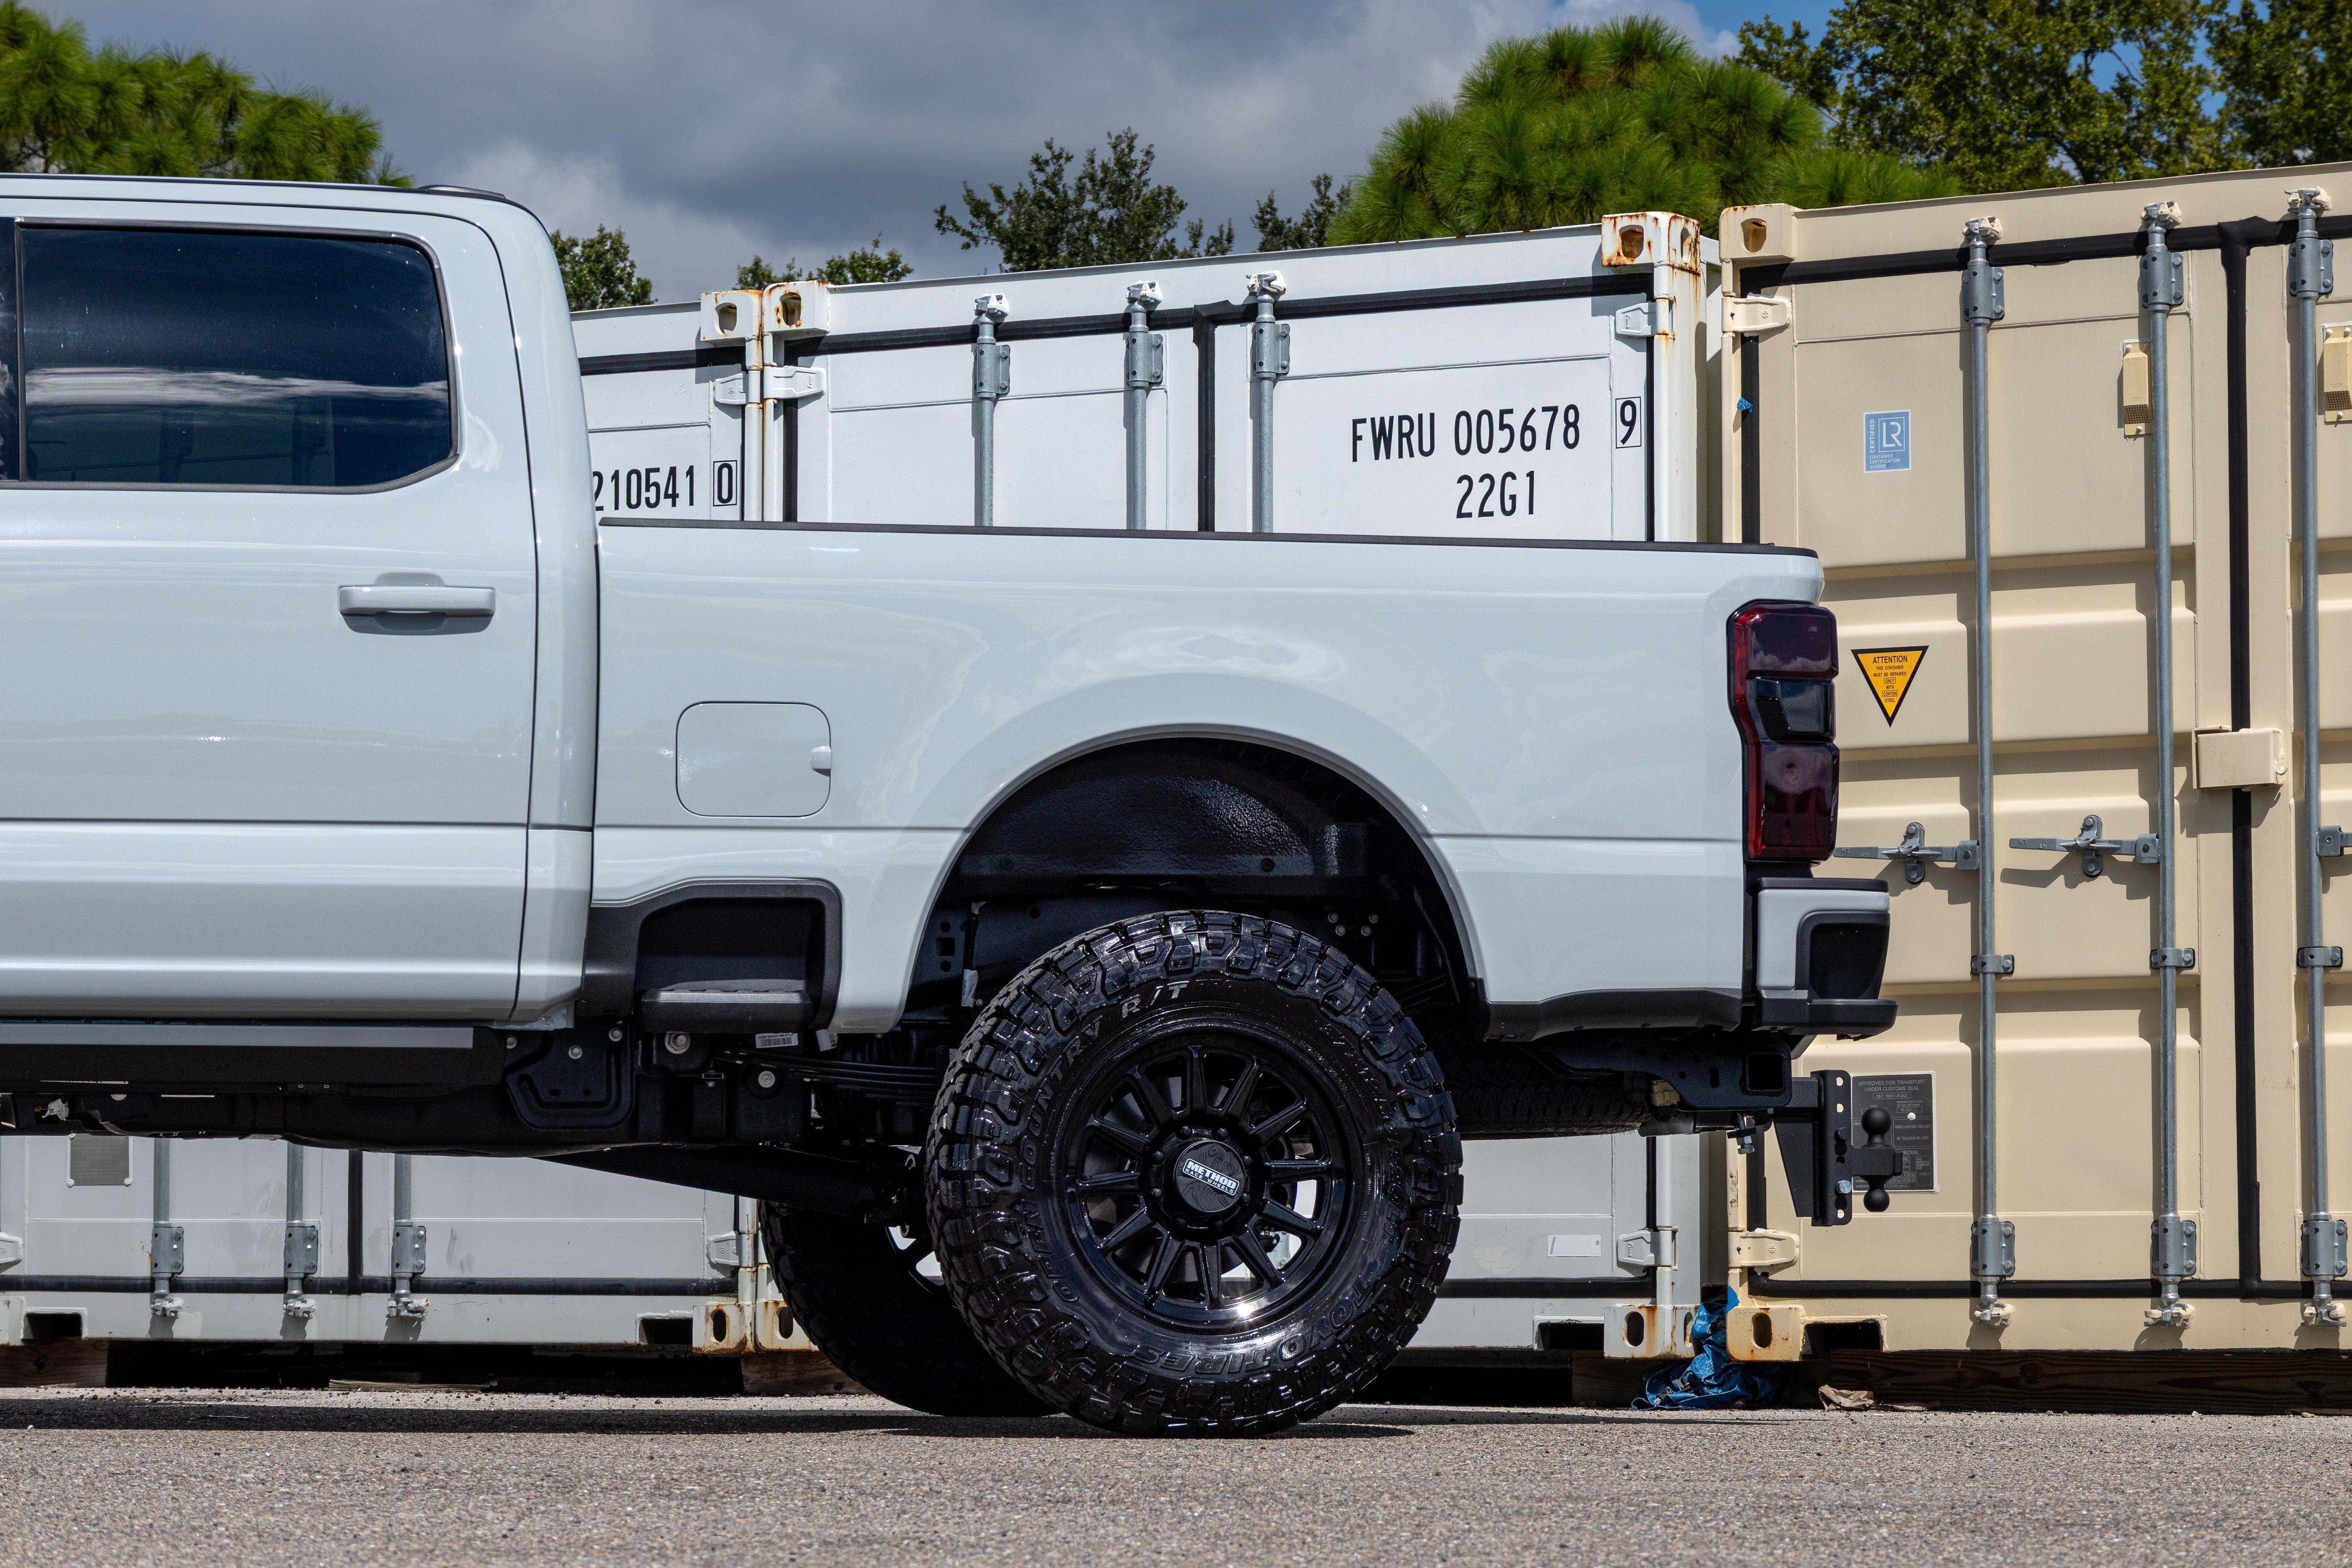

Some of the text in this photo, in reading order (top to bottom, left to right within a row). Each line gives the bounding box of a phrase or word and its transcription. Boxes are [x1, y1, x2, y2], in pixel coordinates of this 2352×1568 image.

[1352, 400, 1637, 462] FWRU 005678 9
[1883, 422, 1902, 447] LR
[592, 462, 733, 511] 210541 0
[1456, 470, 1535, 519] 22G1
[1873, 655, 1907, 664] ATTENTION
[1185, 1169, 1234, 1193] RACE WHEELS
[1187, 1160, 1236, 1189] METHOD
[1279, 1275, 1374, 1361] TOYO
[1132, 1348, 1271, 1374] TIRES
